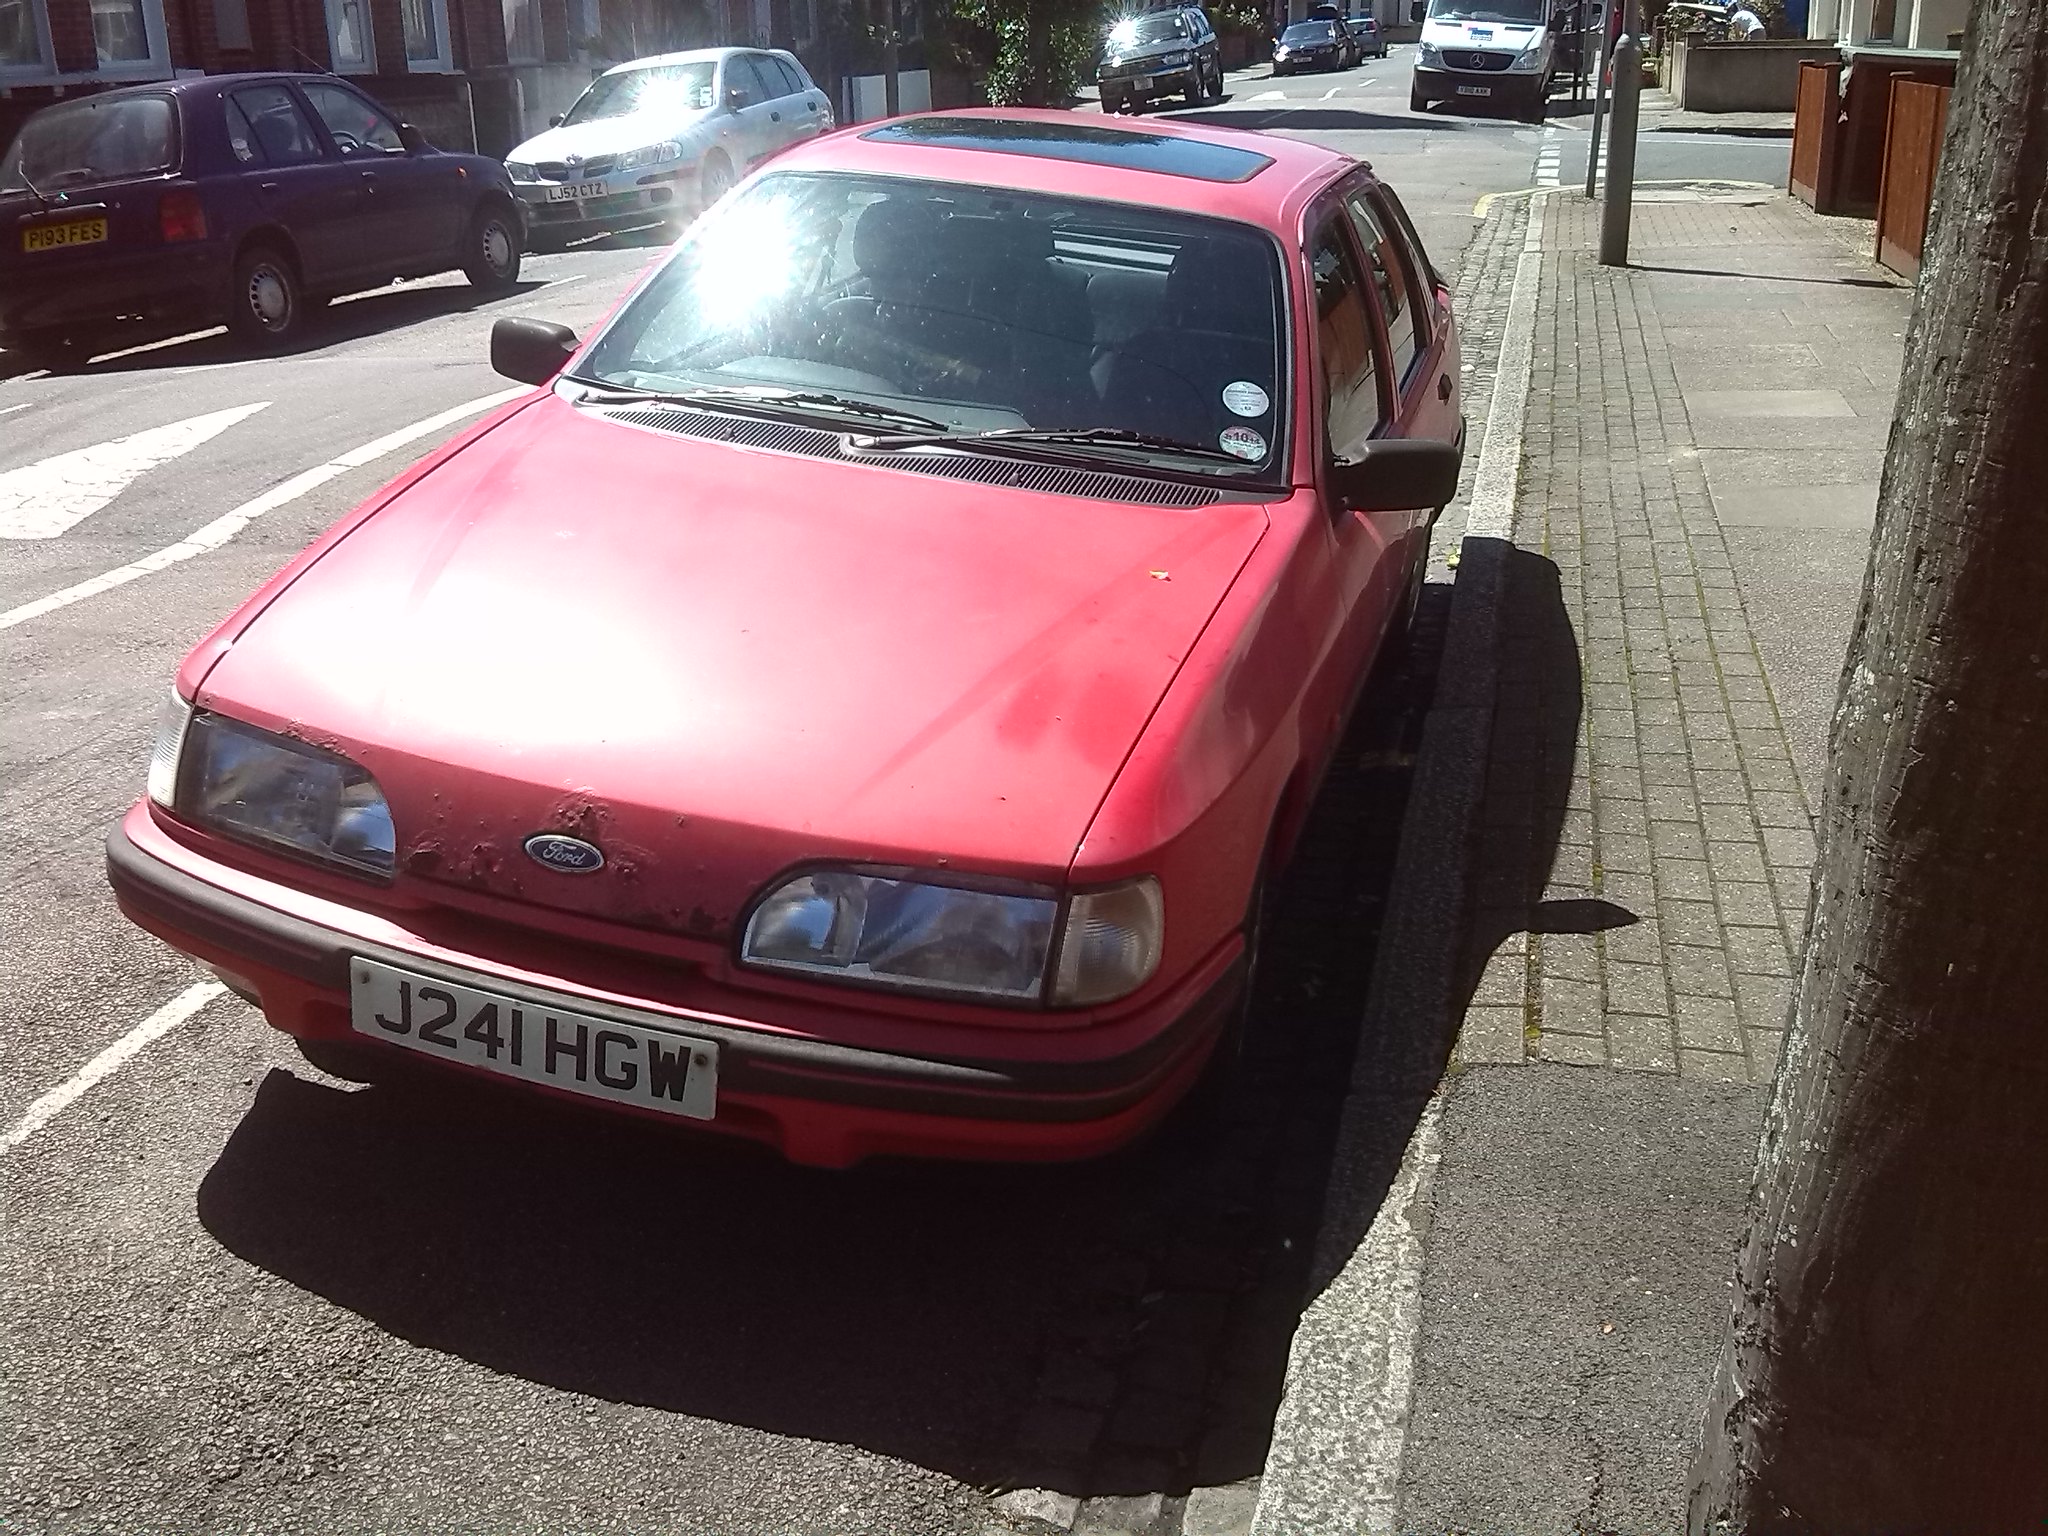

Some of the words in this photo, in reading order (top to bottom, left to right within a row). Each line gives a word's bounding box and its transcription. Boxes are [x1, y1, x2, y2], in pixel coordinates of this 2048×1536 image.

[549, 186, 578, 200] LJ52
[580, 183, 603, 196] CTZ
[29, 228, 65, 248] P193
[69, 223, 102, 242] FES
[543, 841, 586, 865] Ford
[375, 981, 523, 1066] J241
[545, 1016, 692, 1102] HGW
